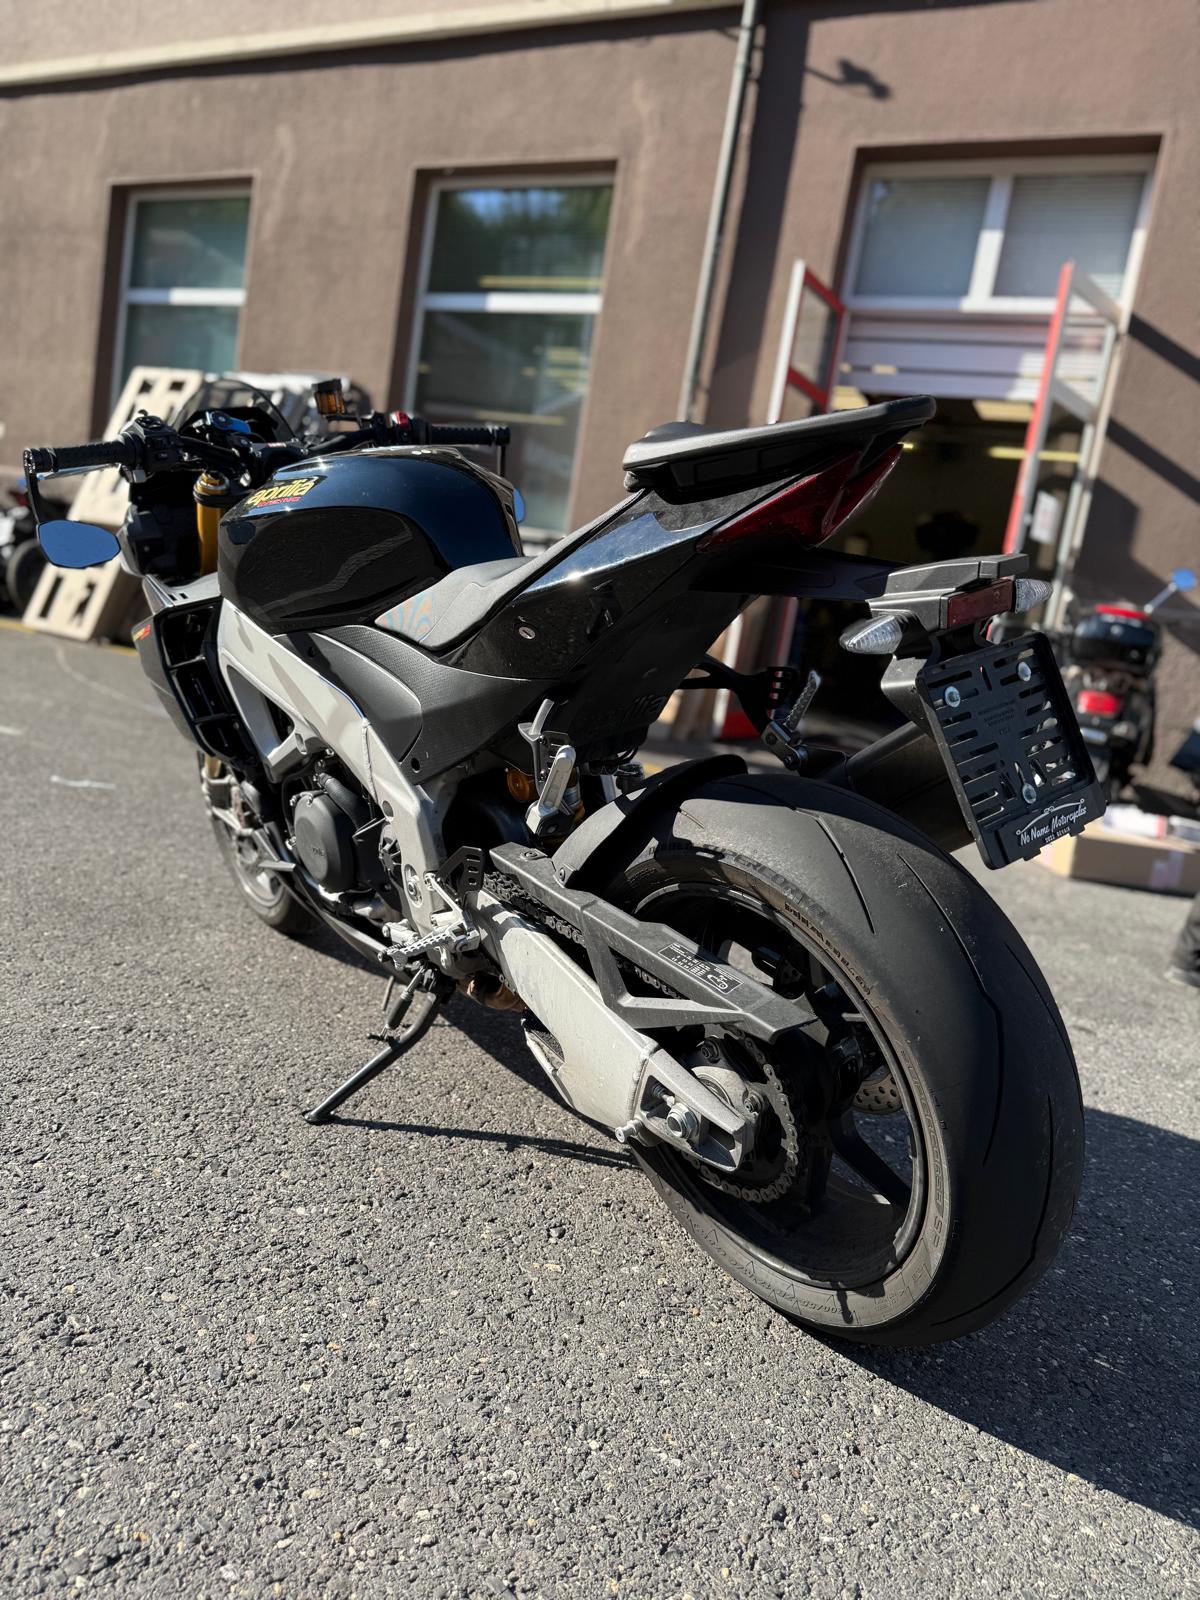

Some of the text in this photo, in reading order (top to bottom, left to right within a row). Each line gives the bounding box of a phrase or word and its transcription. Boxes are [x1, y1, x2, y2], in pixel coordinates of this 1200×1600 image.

[244, 476, 319, 506] aprilia
[1020, 804, 1087, 846] No Name Motorcycles
